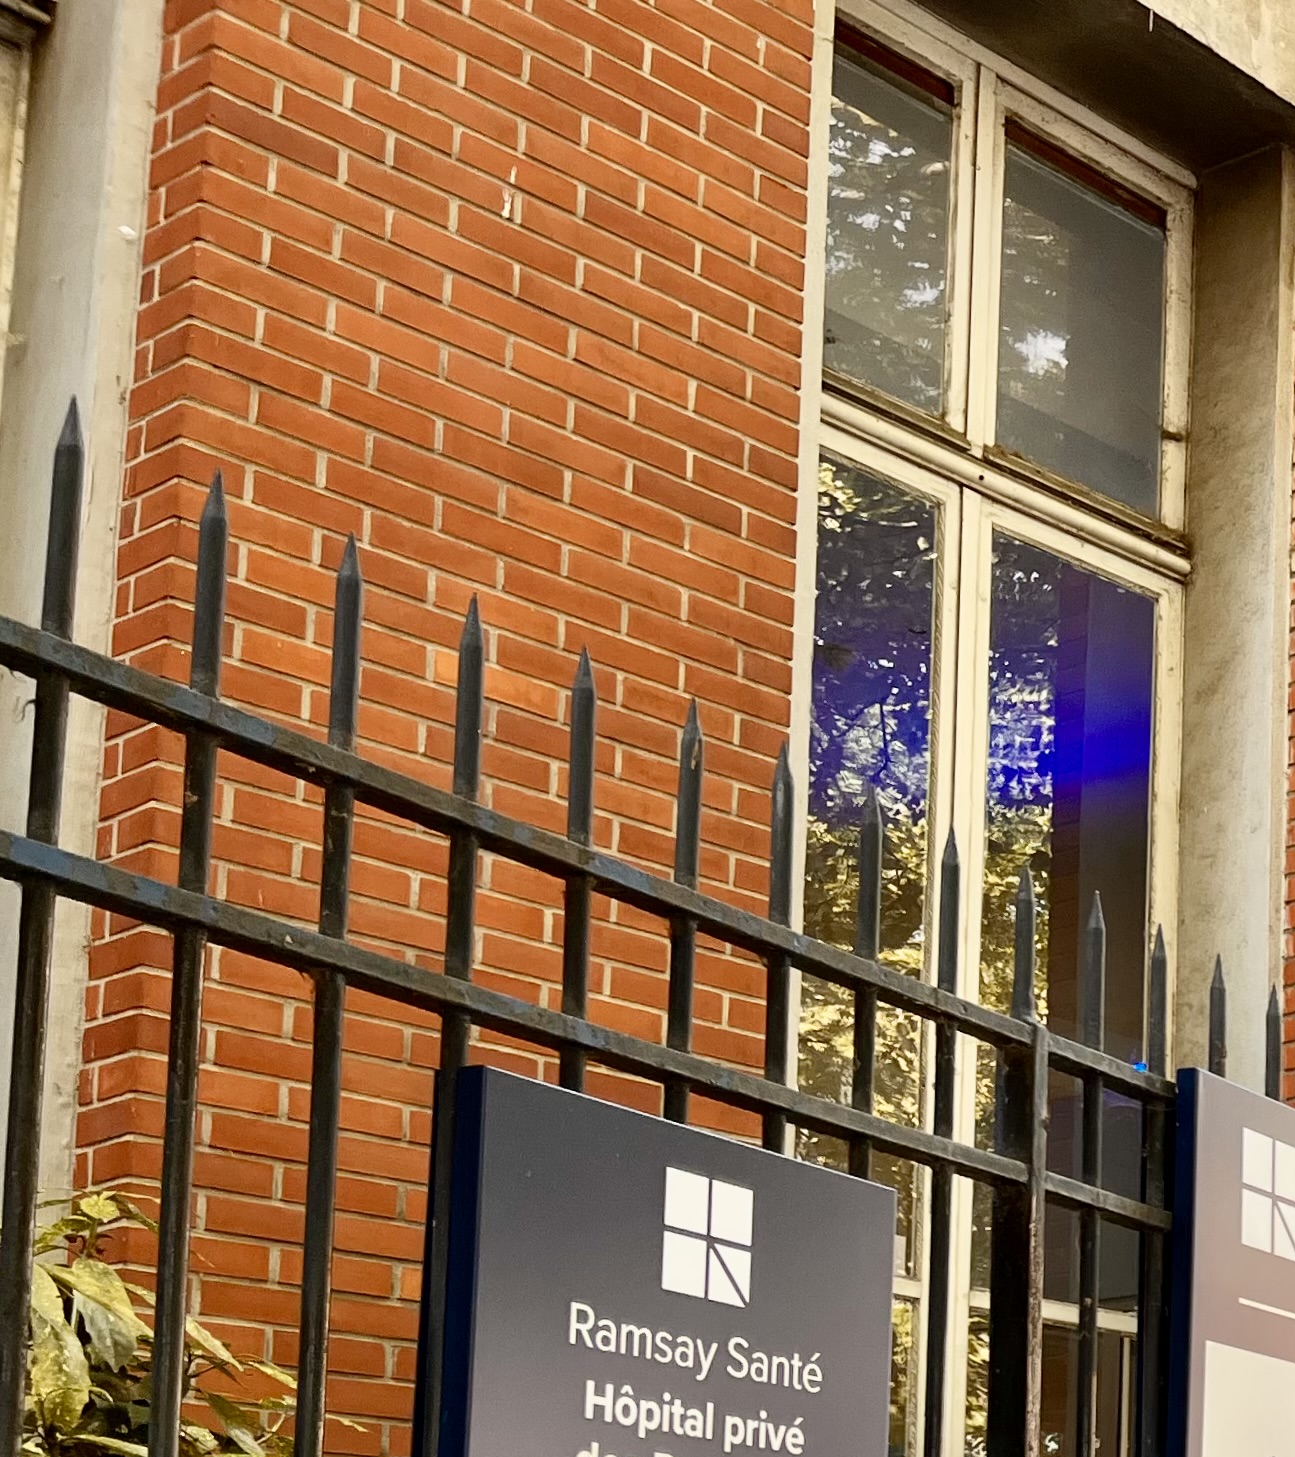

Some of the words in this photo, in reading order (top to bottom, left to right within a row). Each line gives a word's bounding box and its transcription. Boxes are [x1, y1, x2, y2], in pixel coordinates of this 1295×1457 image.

[568, 1301, 718, 1381] Ramsay
[726, 1338, 824, 1395] Santé
[583, 1379, 714, 1441] Hôpital
[723, 1414, 806, 1456] privé
